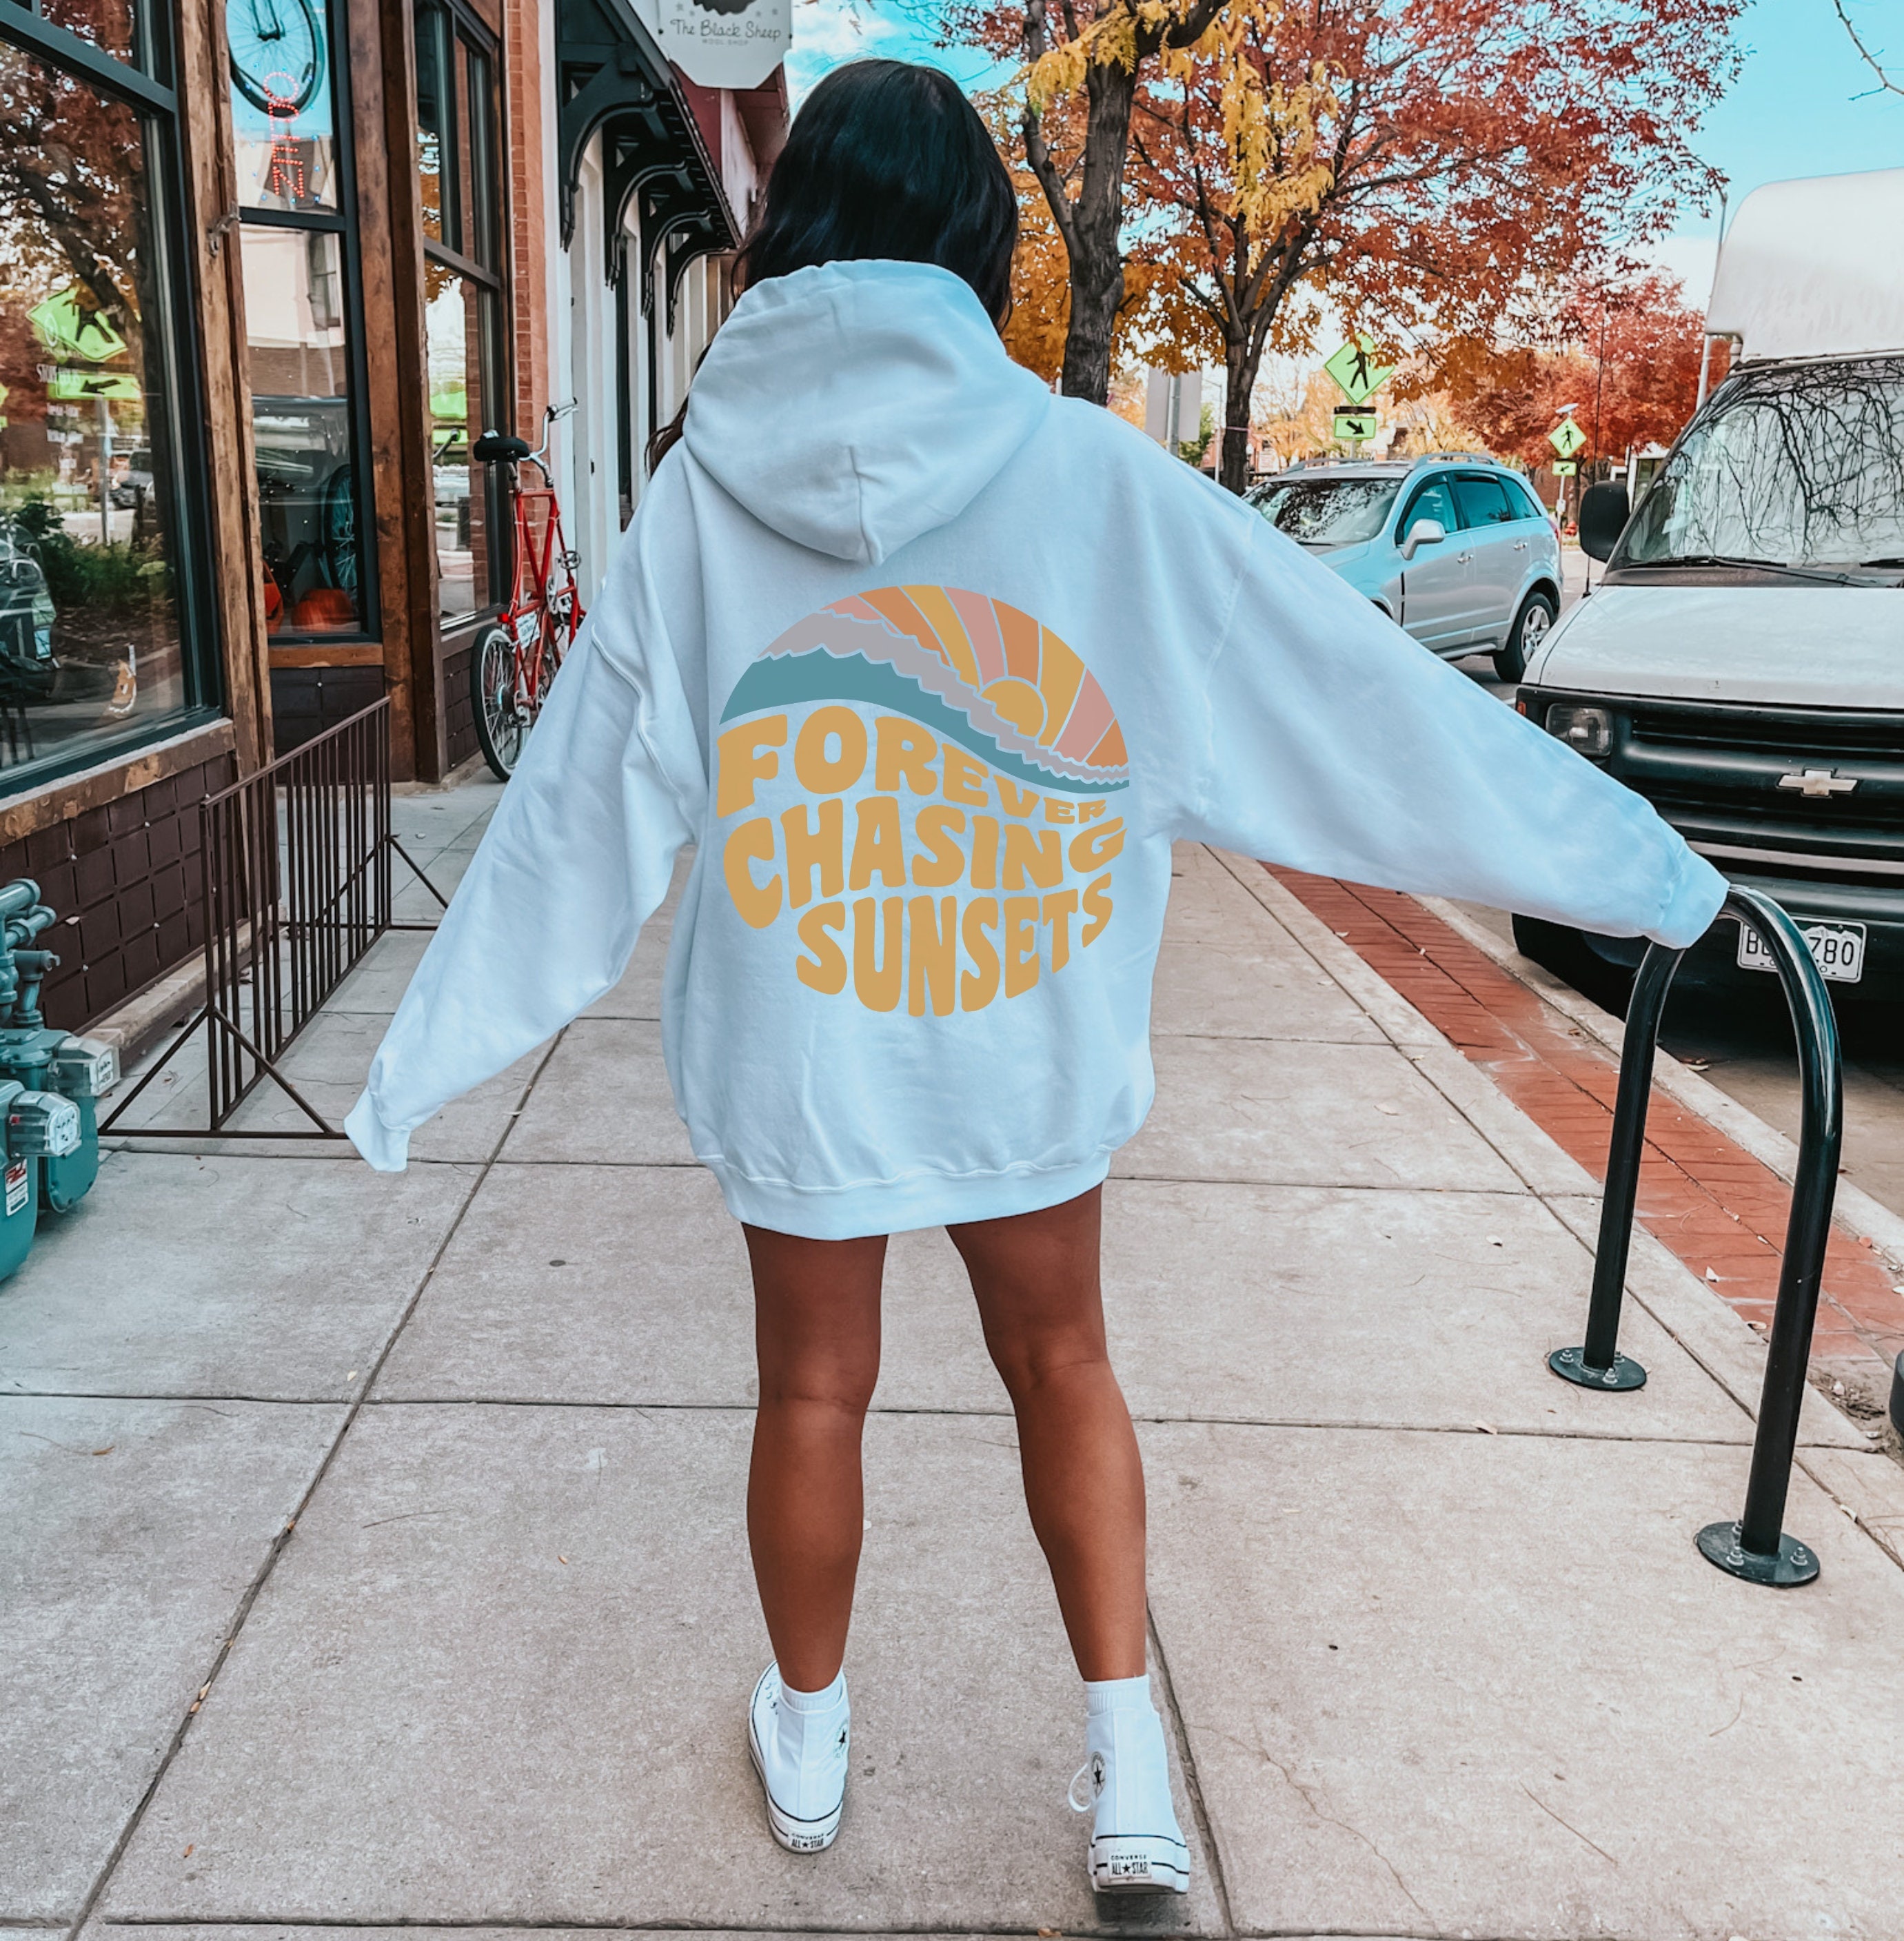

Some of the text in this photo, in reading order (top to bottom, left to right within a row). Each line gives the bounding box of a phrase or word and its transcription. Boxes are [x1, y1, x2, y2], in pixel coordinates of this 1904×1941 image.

[670, 19, 781, 42] The Black Sheep
[263, 71, 305, 199] OPEN
[717, 705, 1107, 824] FOREVER
[724, 796, 1128, 929] CHASING
[796, 872, 1114, 1017] SUNSETS
[1111, 1862, 1148, 1875] ALL STAR
